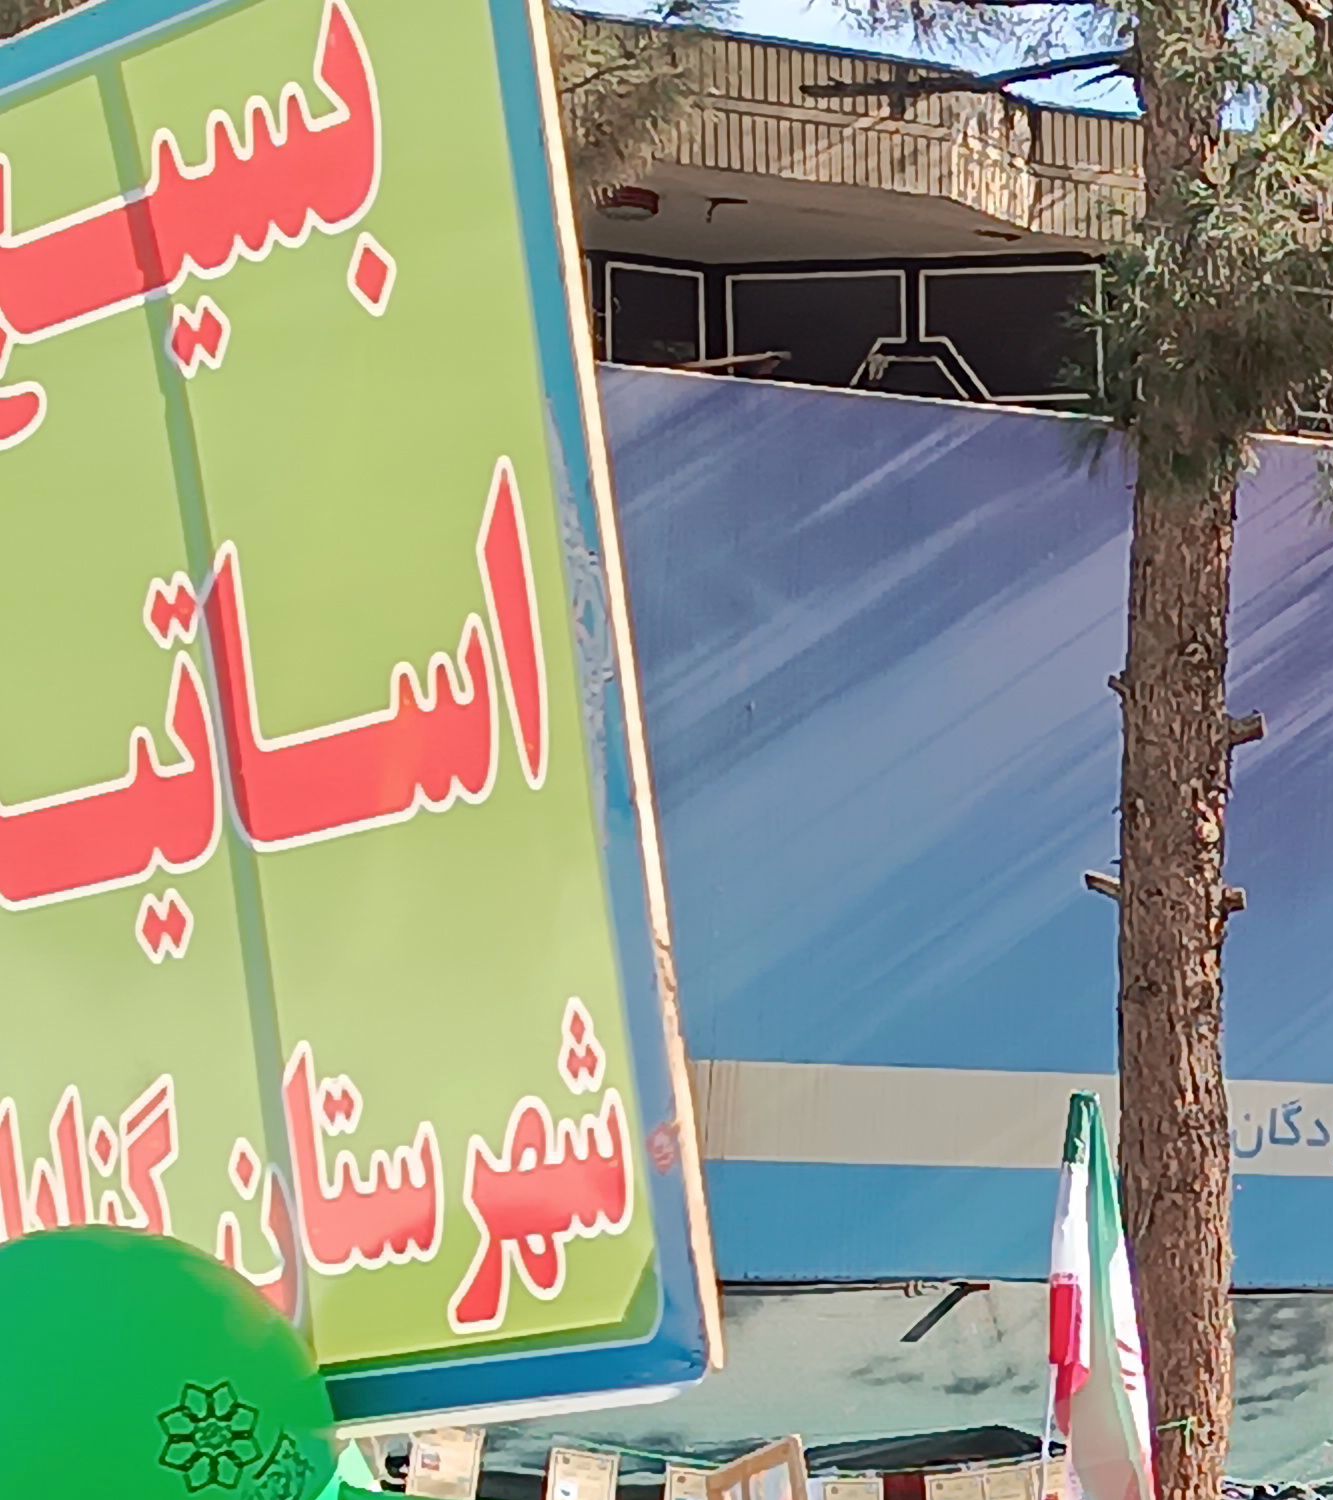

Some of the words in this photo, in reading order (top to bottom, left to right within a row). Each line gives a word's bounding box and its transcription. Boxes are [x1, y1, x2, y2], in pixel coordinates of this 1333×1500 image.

[0, 0, 396, 450] بسی
[0, 456, 548, 963] اساتی
[213, 997, 633, 1335] شهرستان
